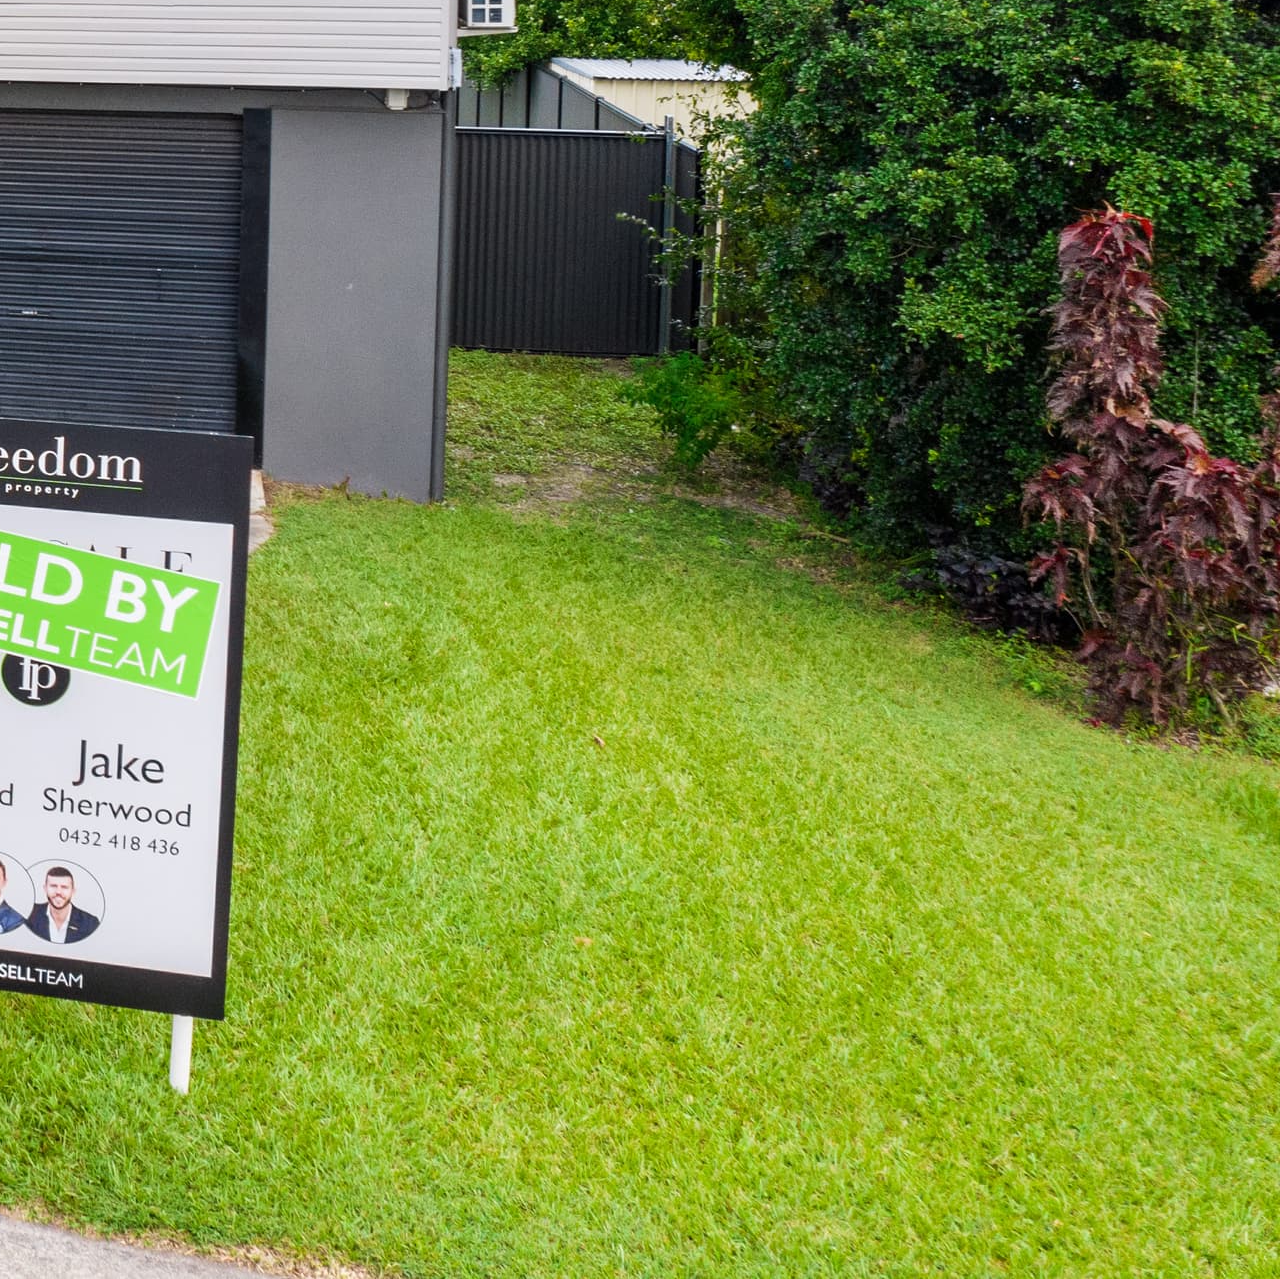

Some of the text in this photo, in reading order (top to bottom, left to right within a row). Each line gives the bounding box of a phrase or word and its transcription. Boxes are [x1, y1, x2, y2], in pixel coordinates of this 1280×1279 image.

[5, 482, 80, 498] property
[104, 570, 199, 633] BY
[71, 739, 166, 787] Jake
[42, 787, 192, 828] Sherwood
[58, 827, 180, 856] 0432 418 436
